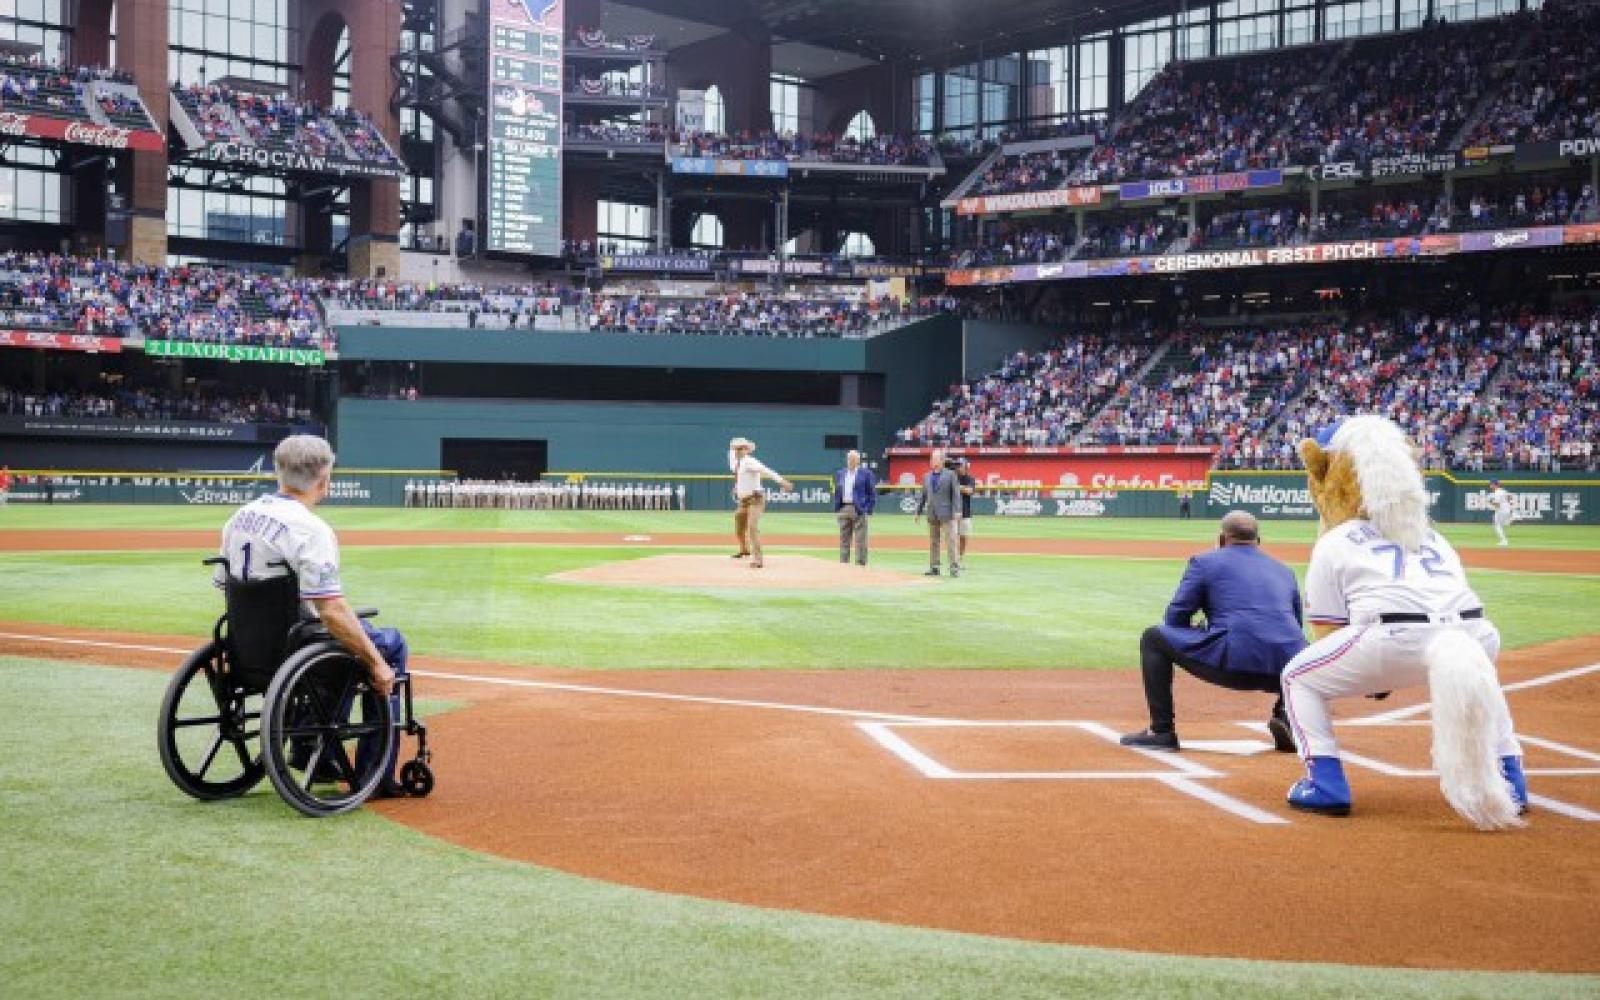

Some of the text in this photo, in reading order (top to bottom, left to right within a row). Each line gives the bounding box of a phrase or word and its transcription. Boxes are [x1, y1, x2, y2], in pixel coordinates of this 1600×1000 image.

[223, 142, 326, 170] CHOCTAW
[1321, 162, 1363, 181] PGL
[1149, 179, 1183, 196] 105.3
[613, 257, 669, 270] PRIORITY
[1154, 242, 1377, 272] CEREMONIAL FIRST PITCH
[166, 342, 322, 363] LUXOR STAFFING
[766, 487, 832, 504] lobe Life
[1233, 485, 1314, 504] Nationa
[241, 541, 251, 581] 1
[1372, 544, 1454, 579] 72
